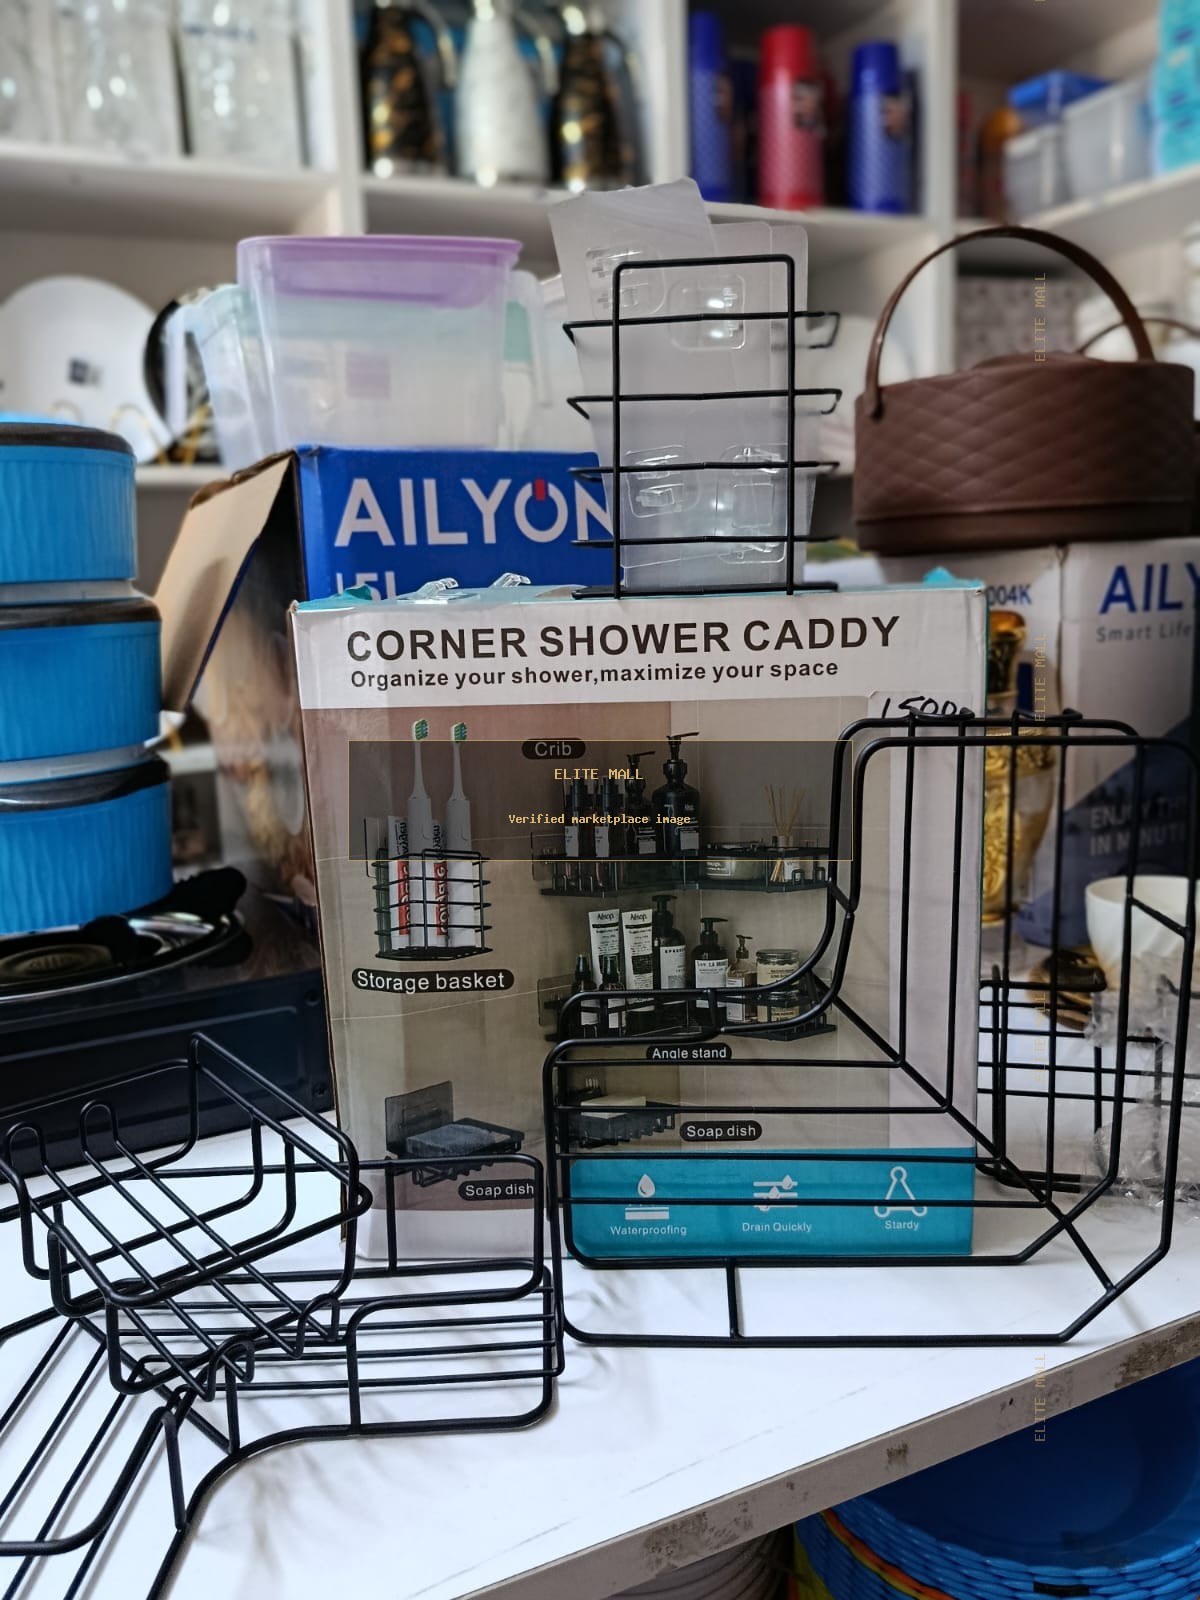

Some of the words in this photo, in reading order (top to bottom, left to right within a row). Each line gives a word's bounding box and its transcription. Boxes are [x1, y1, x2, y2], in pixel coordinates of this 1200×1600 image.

[347, 628, 528, 662] CORNER
[539, 622, 730, 657] SHOWER
[743, 615, 901, 651] CADDY
[1096, 625, 1152, 643] Smart
[1159, 621, 1193, 639] Life
[351, 670, 449, 691] Organize
[455, 670, 506, 689] your
[712, 662, 764, 683] your
[770, 659, 839, 681] space
[534, 740, 573, 758] Crib
[357, 970, 431, 994] Storage
[435, 971, 506, 991] basket
[692, 1047, 728, 1058] stand
[686, 1124, 724, 1139] Soap
[727, 1123, 756, 1136] dish
[464, 1183, 502, 1197] Soap
[505, 1182, 535, 1195] dish
[610, 1224, 687, 1236] Waterproofing
[742, 1222, 770, 1233] Drain
[772, 1221, 812, 1233] Quickly
